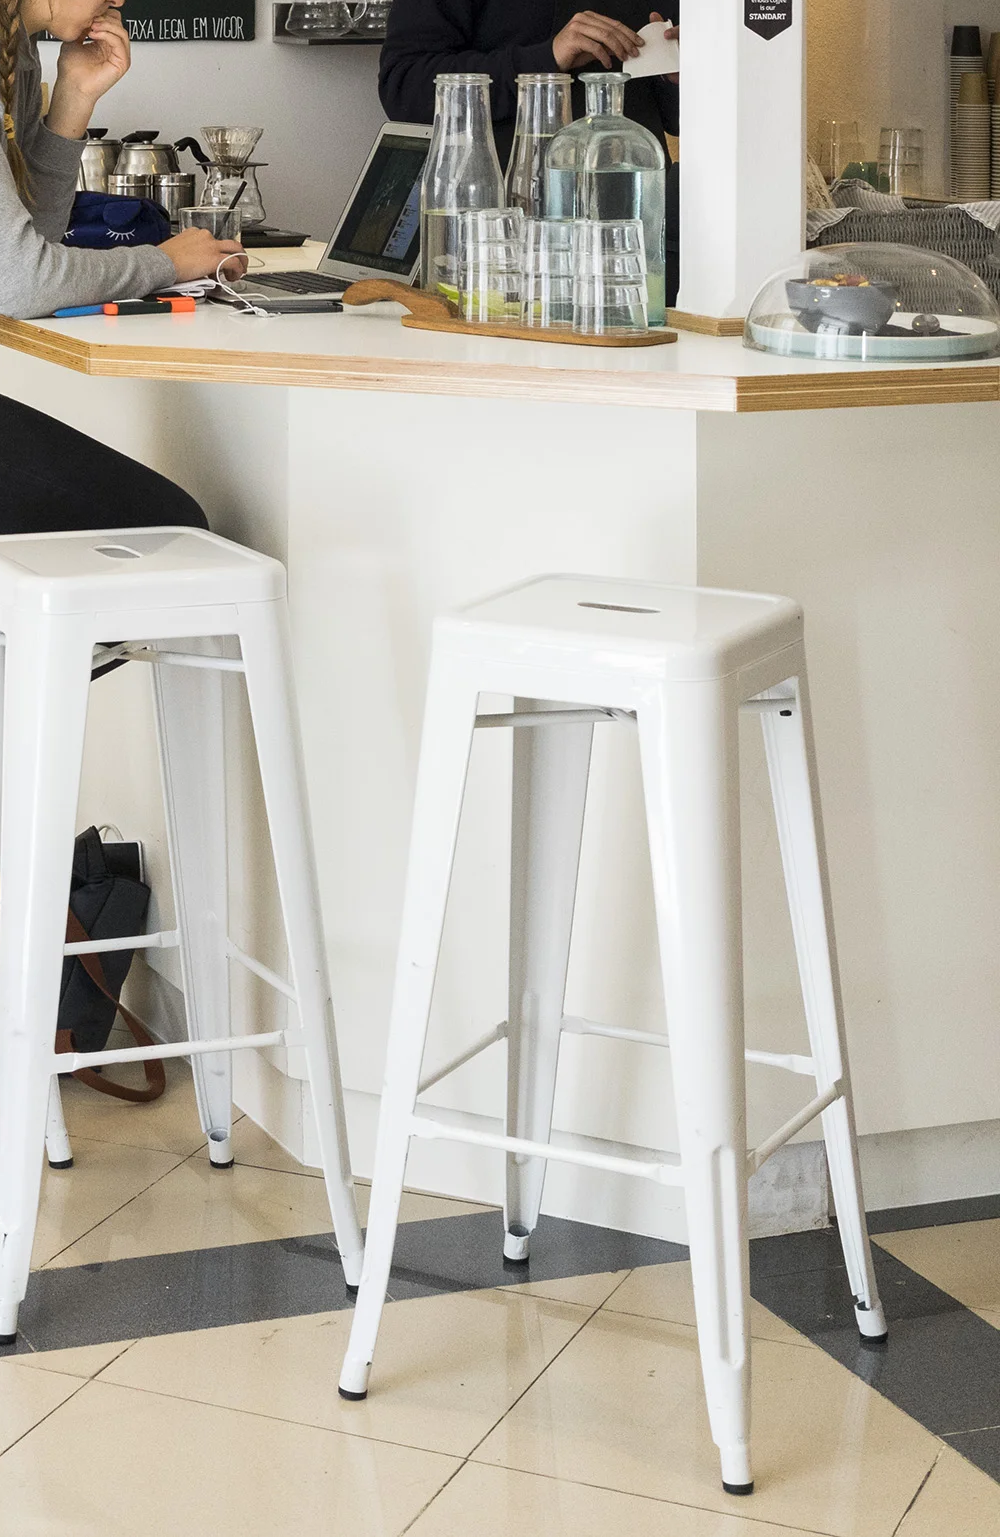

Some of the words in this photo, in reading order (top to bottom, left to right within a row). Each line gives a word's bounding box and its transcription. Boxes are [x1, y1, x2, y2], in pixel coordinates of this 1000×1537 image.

[127, 19, 154, 40] TAXA
[159, 19, 188, 39] LEGAL
[194, 17, 207, 38] EM
